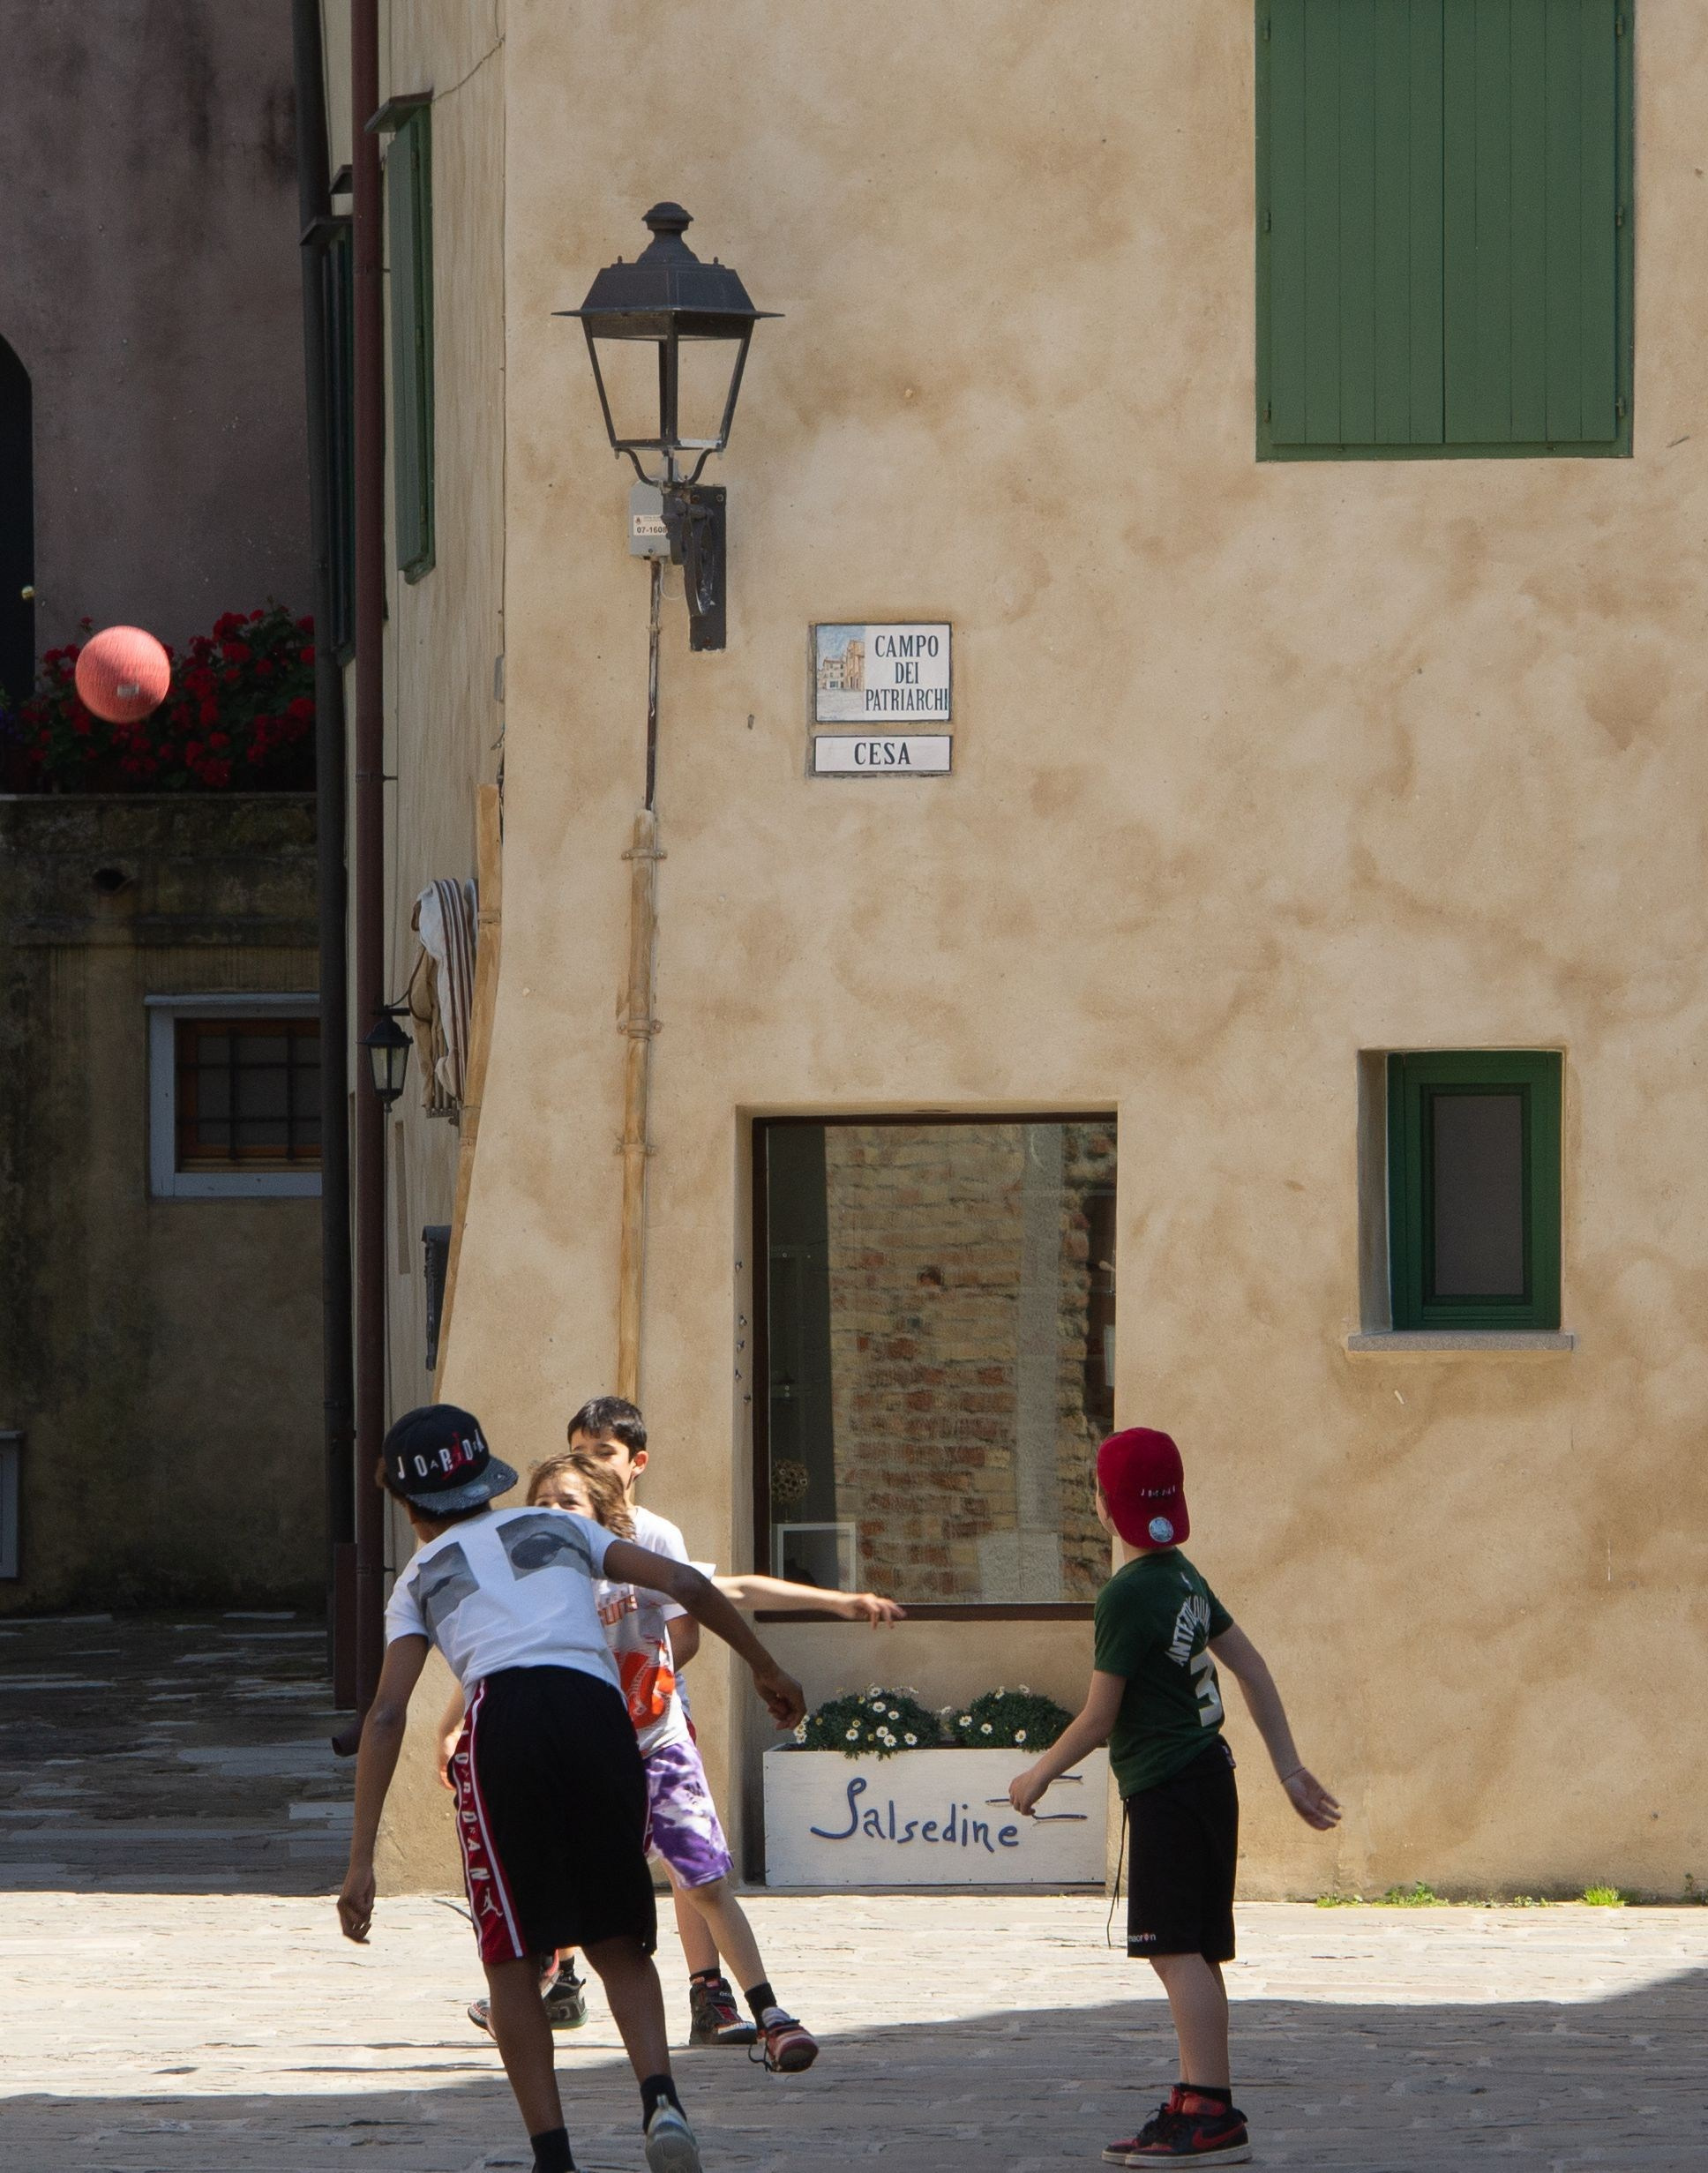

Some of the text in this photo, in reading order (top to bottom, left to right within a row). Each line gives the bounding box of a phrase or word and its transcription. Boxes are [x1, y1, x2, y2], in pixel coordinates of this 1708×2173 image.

[875, 635, 939, 657] CAMPO
[895, 662, 919, 684] DEI
[865, 688, 948, 711] PATRIARCHI
[854, 742, 911, 765] CESA
[397, 1428, 485, 1480] JORDA
[810, 1777, 1020, 1854] Salsedine
